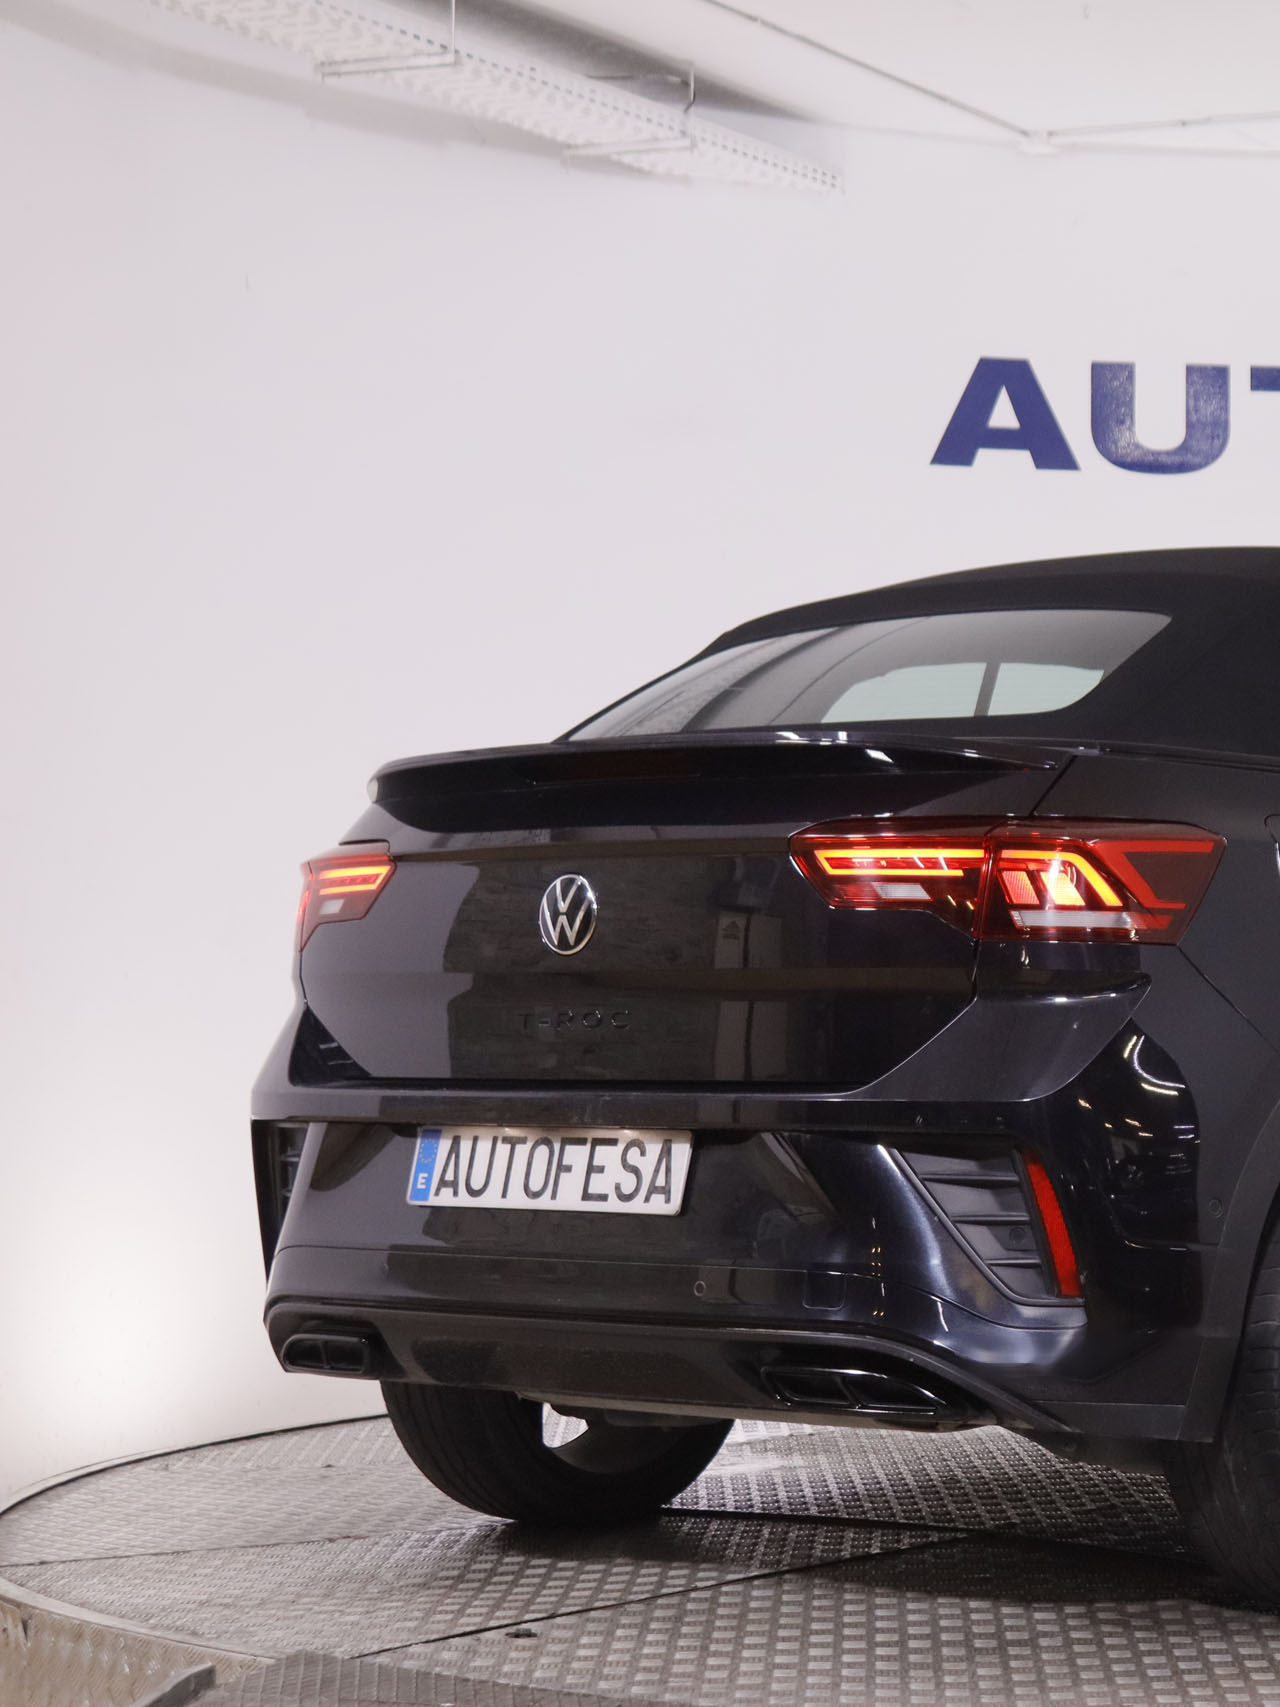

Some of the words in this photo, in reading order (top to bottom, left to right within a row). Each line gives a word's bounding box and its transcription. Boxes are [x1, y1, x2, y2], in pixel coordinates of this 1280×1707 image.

[518, 1009, 630, 1031] T-ROC
[416, 1172, 428, 1190] E
[434, 1134, 673, 1205] AUTOFESA
